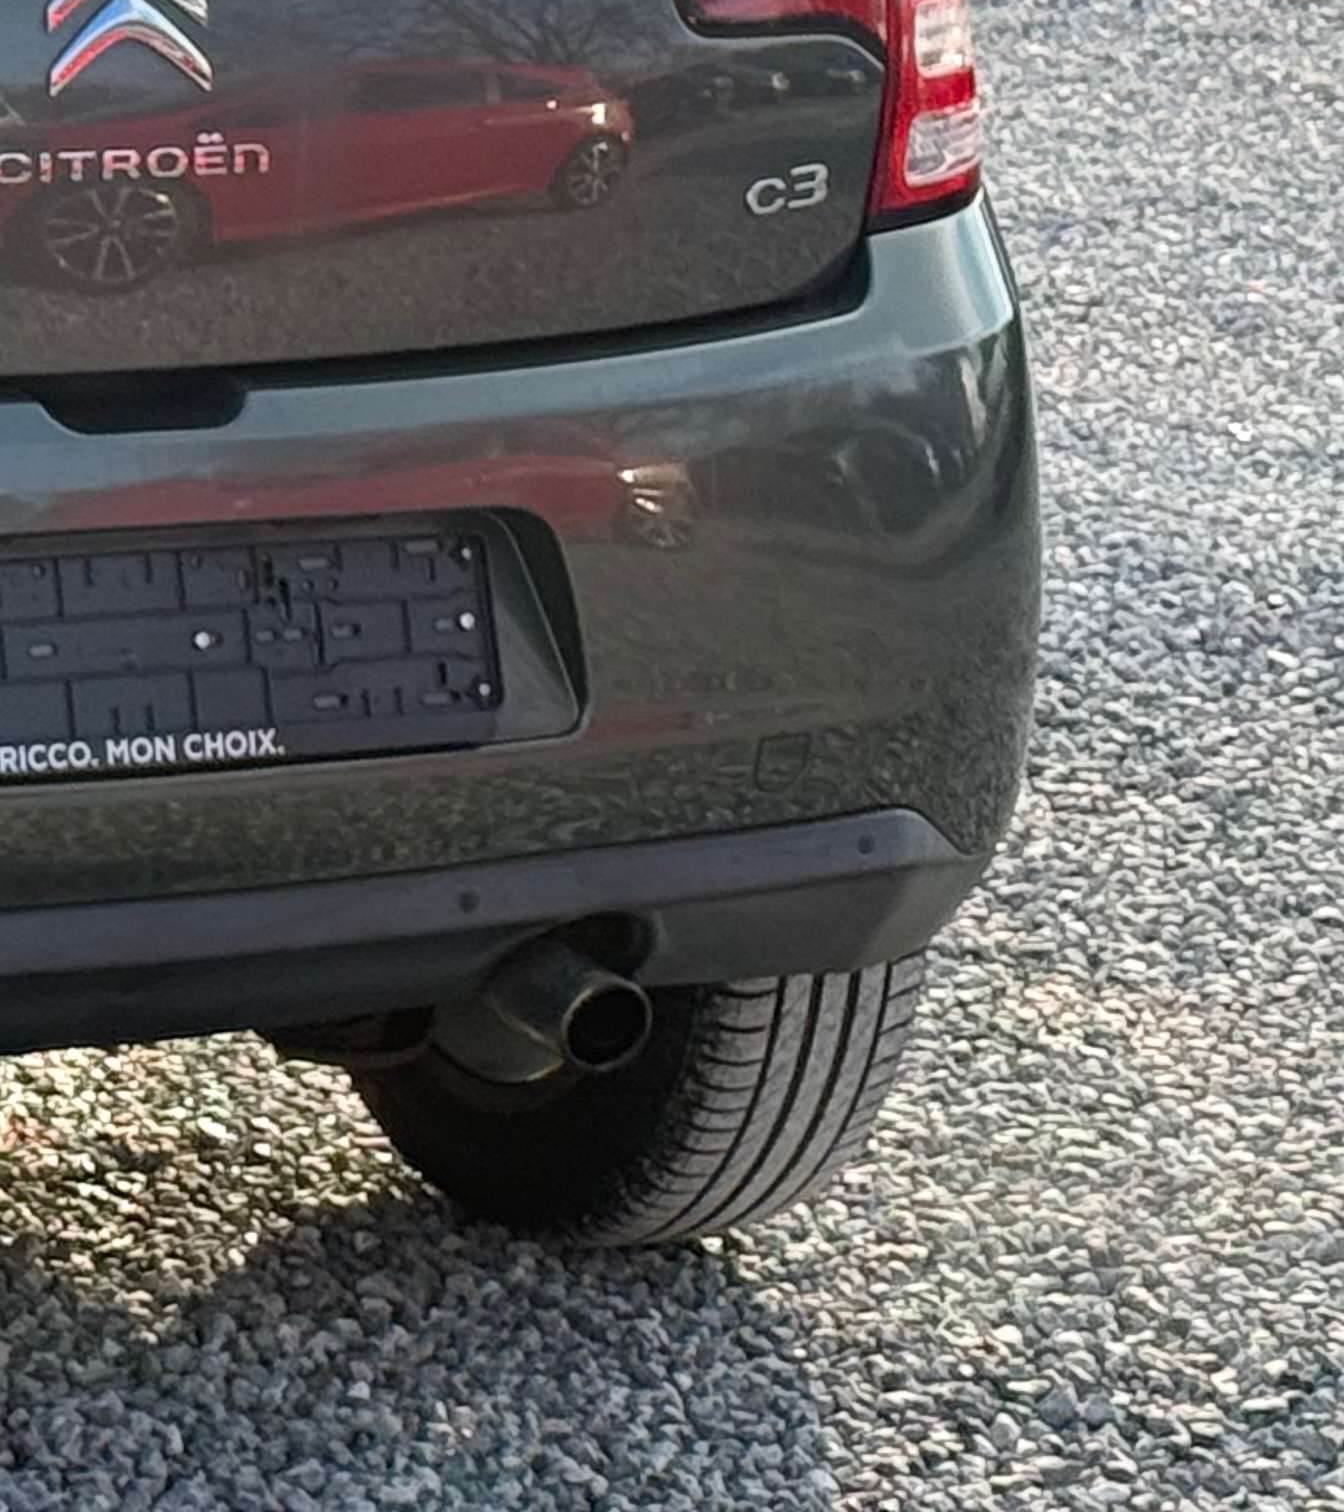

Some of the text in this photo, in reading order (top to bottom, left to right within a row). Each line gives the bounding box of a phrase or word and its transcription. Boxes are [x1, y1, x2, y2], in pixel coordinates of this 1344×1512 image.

[745, 163, 829, 215] C3
[105, 735, 177, 767] MON
[183, 727, 286, 761] CHOIX.
